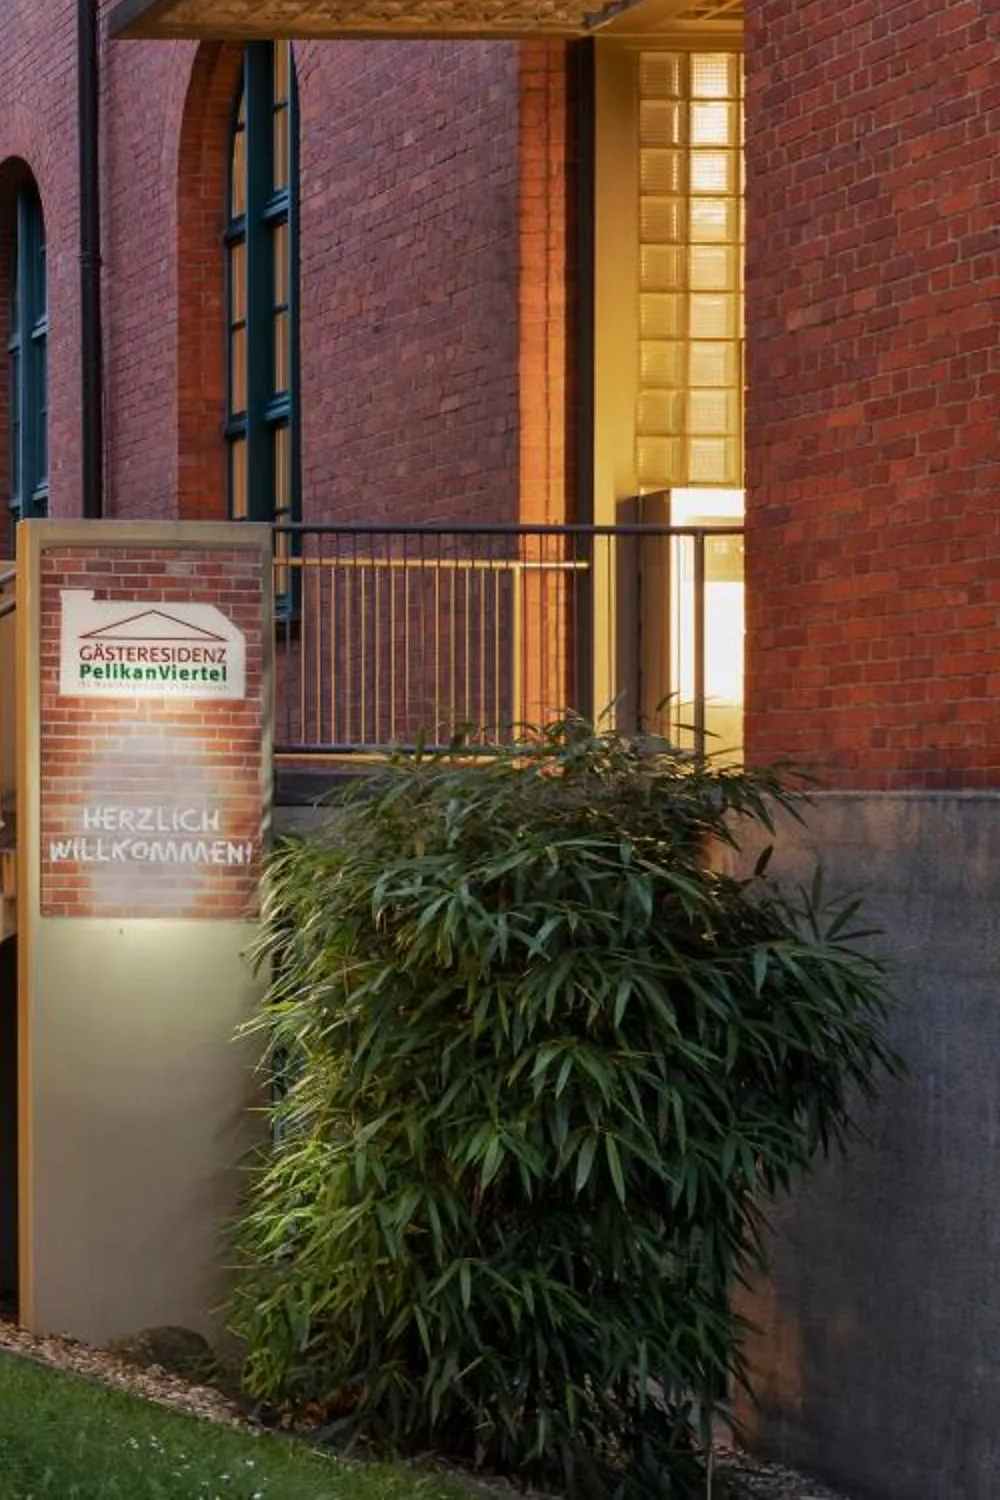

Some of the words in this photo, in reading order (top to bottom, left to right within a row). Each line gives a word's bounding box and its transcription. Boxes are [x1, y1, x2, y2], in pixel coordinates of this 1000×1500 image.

[79, 644, 227, 663] GÄSTERESIDENZ
[79, 663, 227, 681] PelikanViertel
[83, 806, 220, 832] HERZLICH
[50, 836, 253, 864] WILLKOMMEN!
